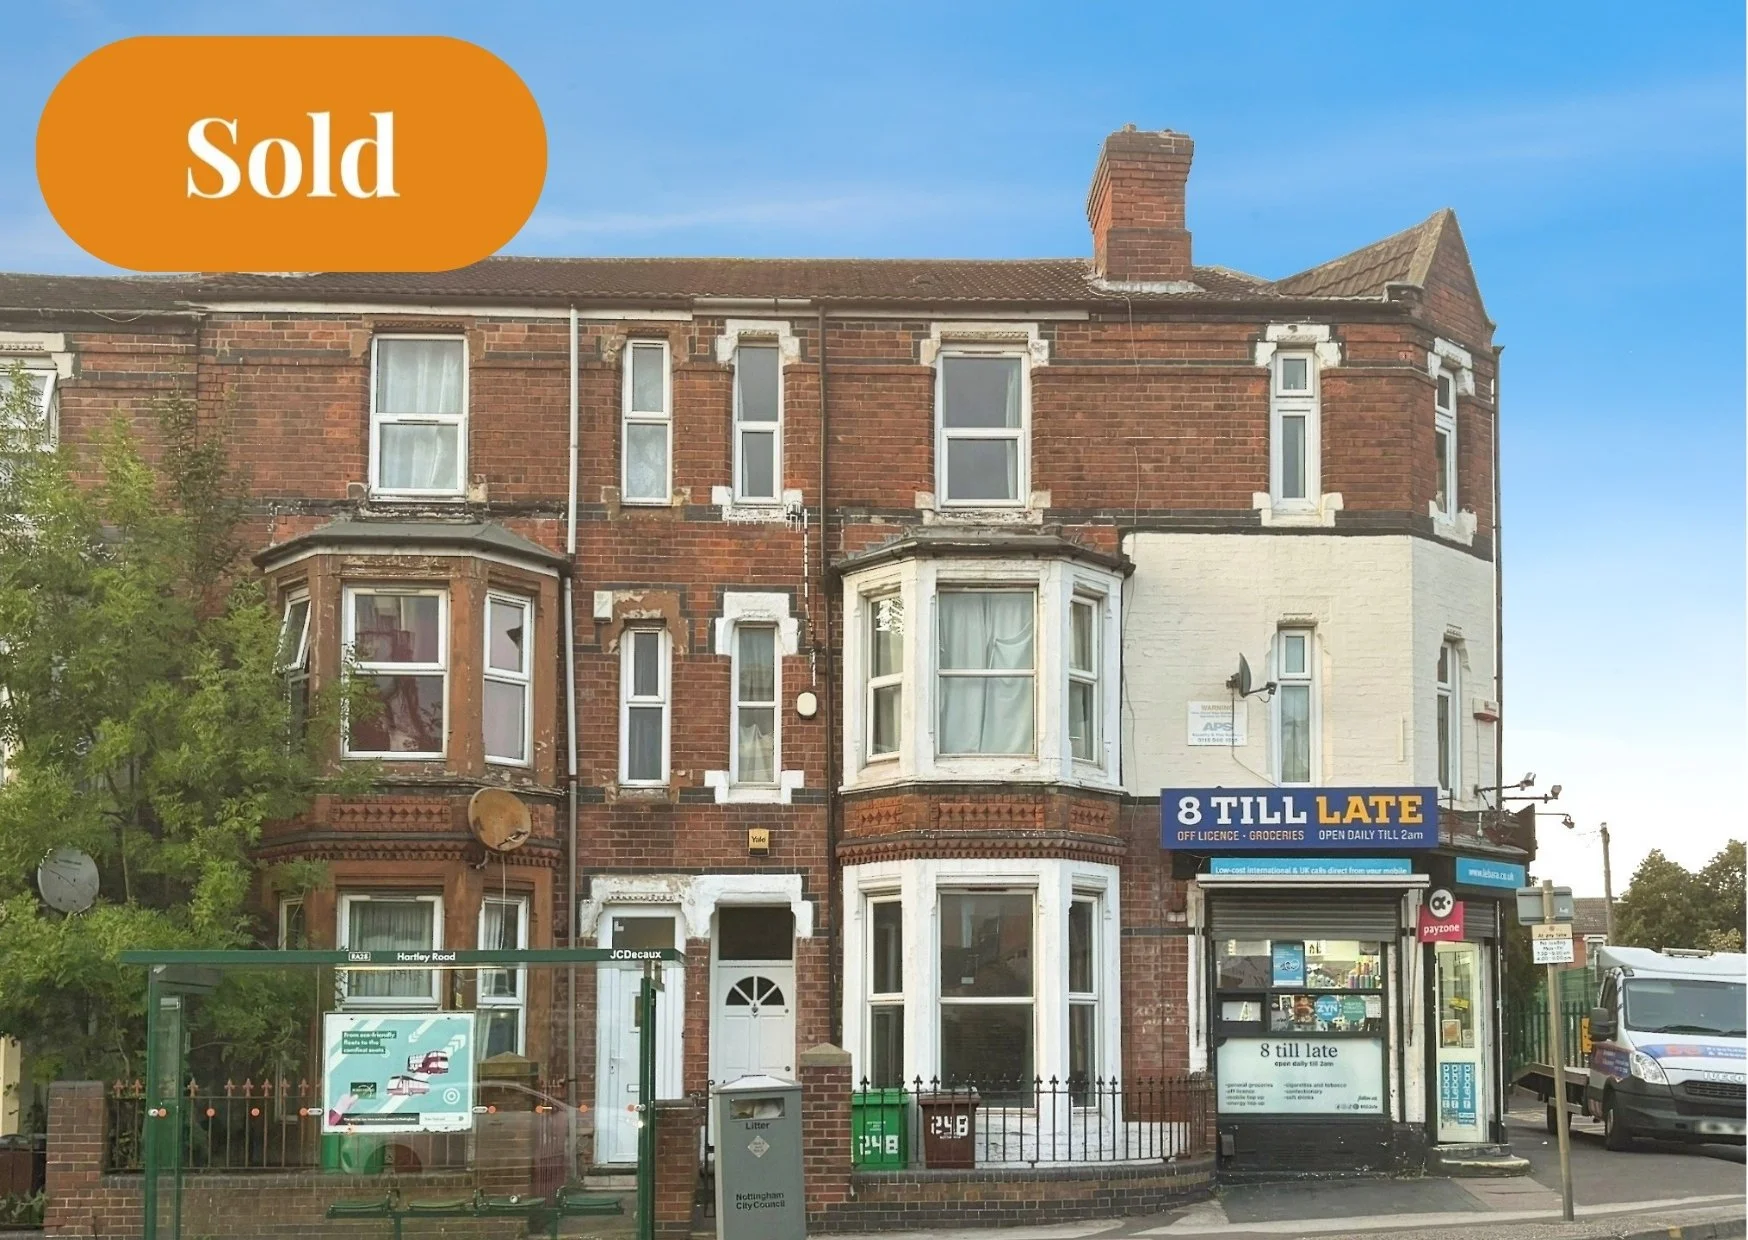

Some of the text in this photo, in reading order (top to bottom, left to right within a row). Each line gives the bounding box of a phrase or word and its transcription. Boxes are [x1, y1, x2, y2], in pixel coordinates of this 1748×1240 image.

[1202, 721, 1234, 732] APS
[1177, 795, 1423, 826] 8 TILL LATE
[1177, 830, 1196, 841] OFF
[1198, 830, 1240, 841] LICENCE
[1249, 830, 1304, 841] GROCERIES
[1319, 829, 1424, 840] OPEN DAILY TILL 2am
[1423, 924, 1460, 936] payzone
[397, 952, 456, 963] Hartley Road
[610, 950, 662, 959] JCDecaux
[1317, 1004, 1338, 1012] ZYN
[1260, 1043, 1338, 1058] 8 till late
[1703, 1071, 1745, 1083] IVECO
[745, 1122, 770, 1130] Litter
[931, 1115, 969, 1137] 248
[859, 1135, 898, 1155] 248
[736, 1192, 784, 1202] Nottingham
[736, 1201, 785, 1211] City Council
